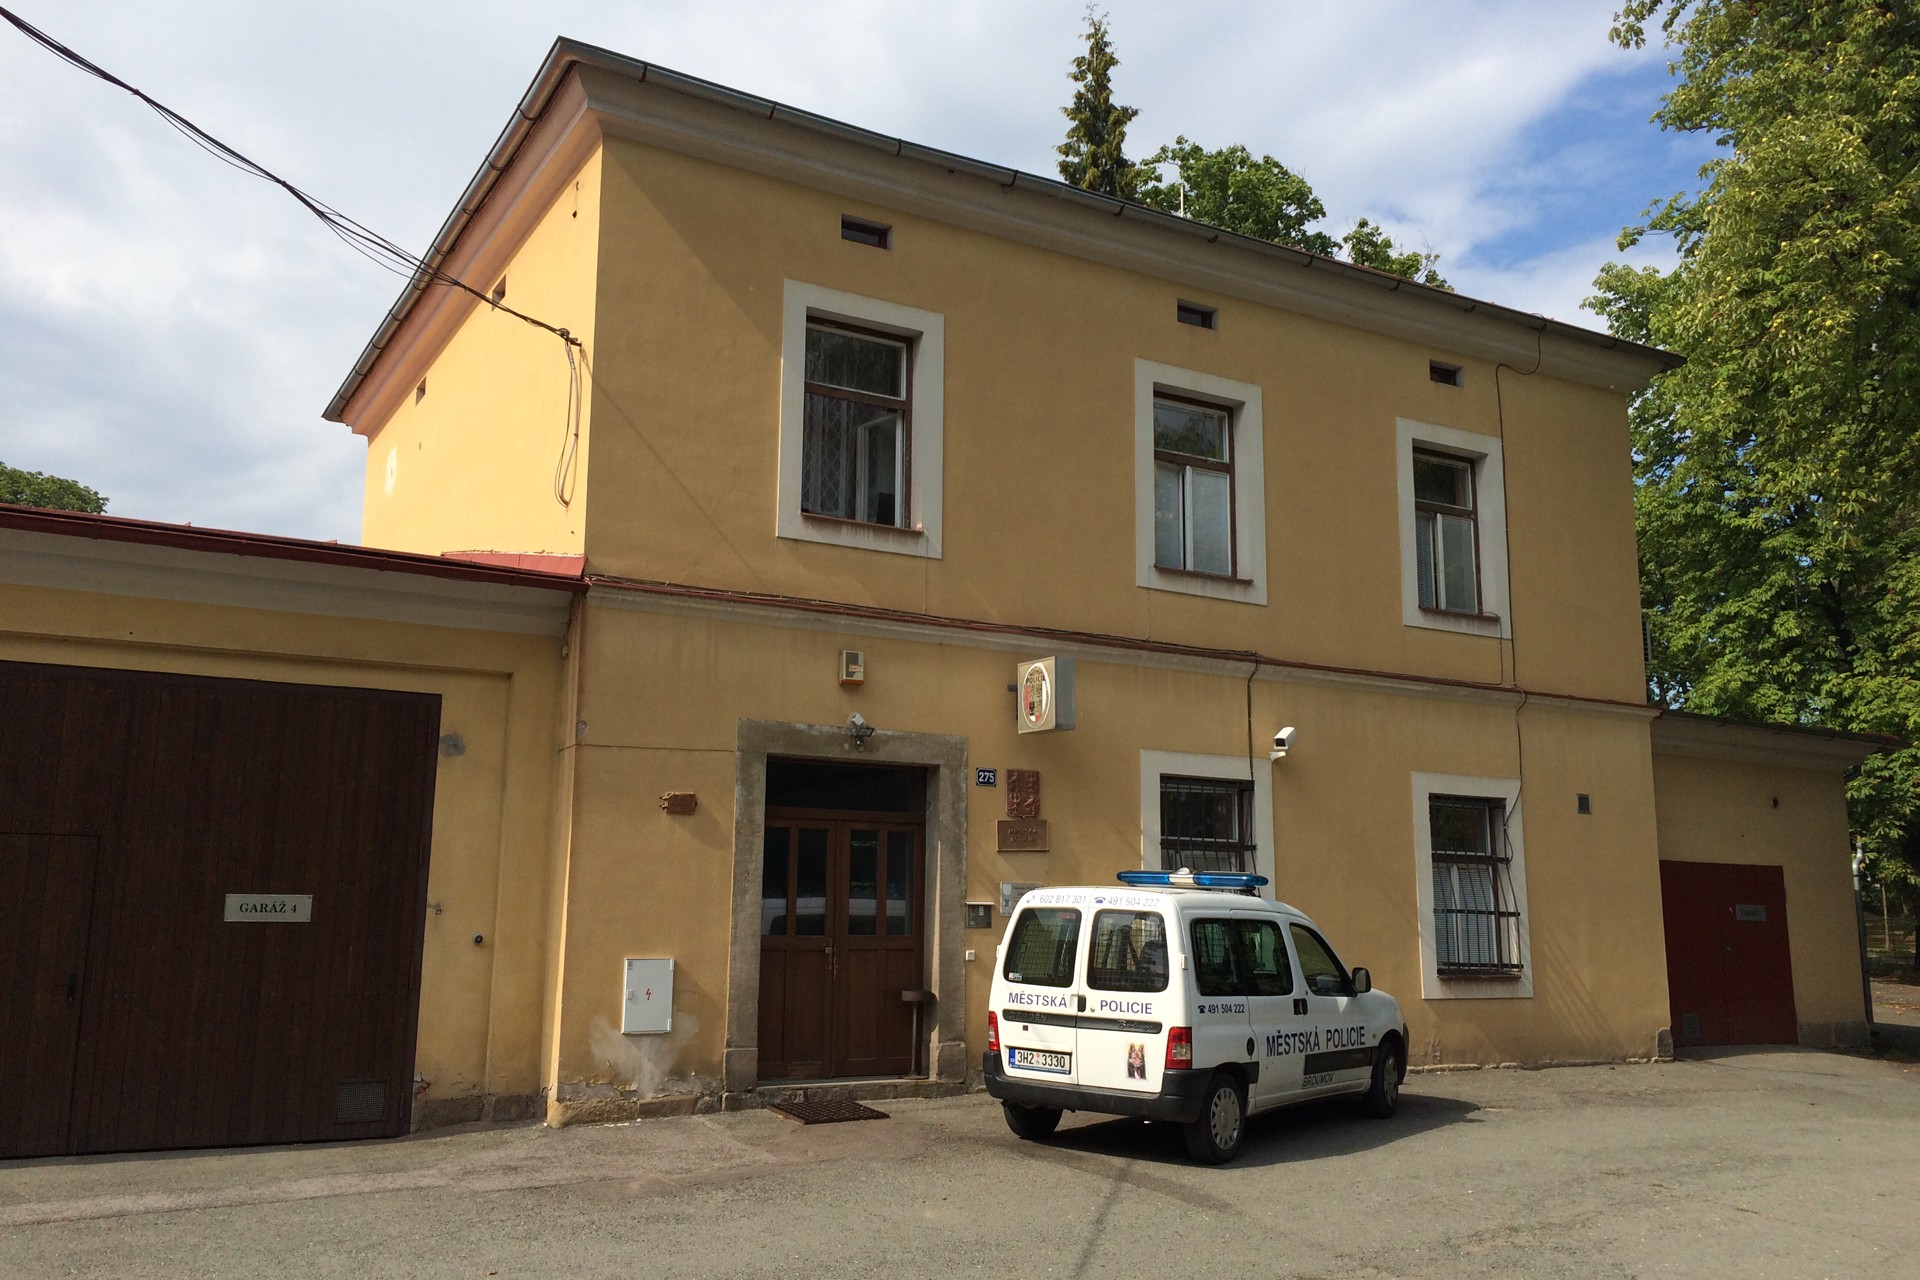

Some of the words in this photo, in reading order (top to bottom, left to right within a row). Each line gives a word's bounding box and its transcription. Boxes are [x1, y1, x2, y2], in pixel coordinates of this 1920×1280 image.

[978, 771, 995, 783] 275
[1039, 894, 1053, 904] 602
[1055, 895, 1070, 904] 817
[1072, 895, 1086, 904] 301
[1108, 896, 1123, 906] 491
[1125, 896, 1141, 906] 504
[1143, 897, 1160, 907] 222
[239, 900, 287, 913] GARÁŽ
[291, 903, 297, 913] 4
[1008, 990, 1067, 1008] MĚSTSKÁ
[1100, 999, 1152, 1014] POLICIE
[1208, 1004, 1219, 1014] 491
[1221, 1004, 1233, 1014] 504
[1234, 1003, 1245, 1014] 222
[1266, 1026, 1320, 1057] MĚSTSKÁ
[1326, 1026, 1365, 1049] POLICIE
[1017, 1051, 1035, 1065] 3H2
[1041, 1053, 1066, 1068] 3330
[1303, 1072, 1335, 1087] BROUMOV
